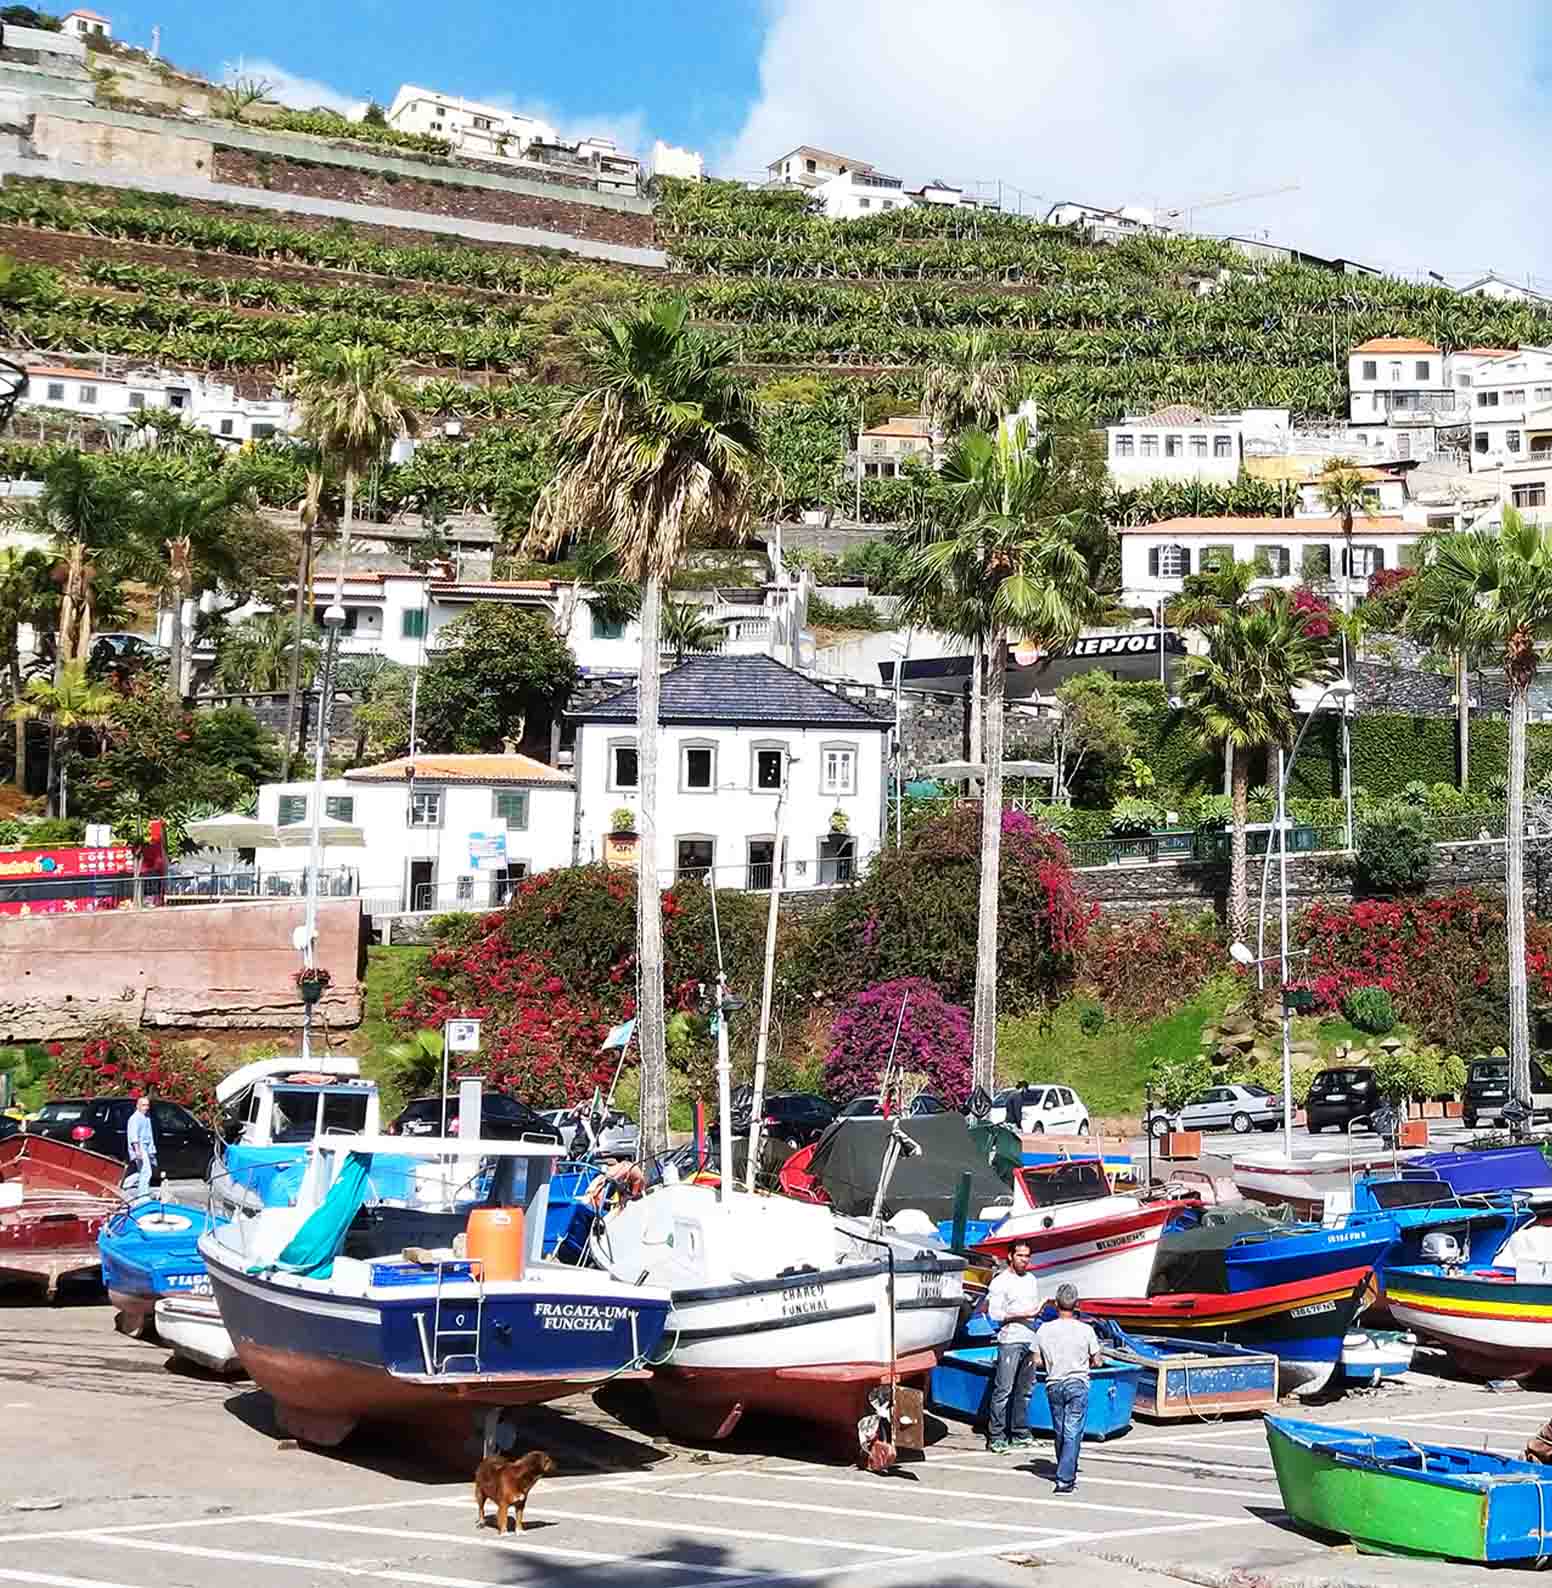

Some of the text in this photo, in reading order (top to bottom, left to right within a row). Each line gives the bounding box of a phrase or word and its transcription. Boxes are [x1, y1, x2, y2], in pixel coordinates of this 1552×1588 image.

[1069, 635, 1157, 656] REPSOL
[782, 1298, 830, 1316] FUNCHAL
[544, 1317, 614, 1331] FUNCHAL
